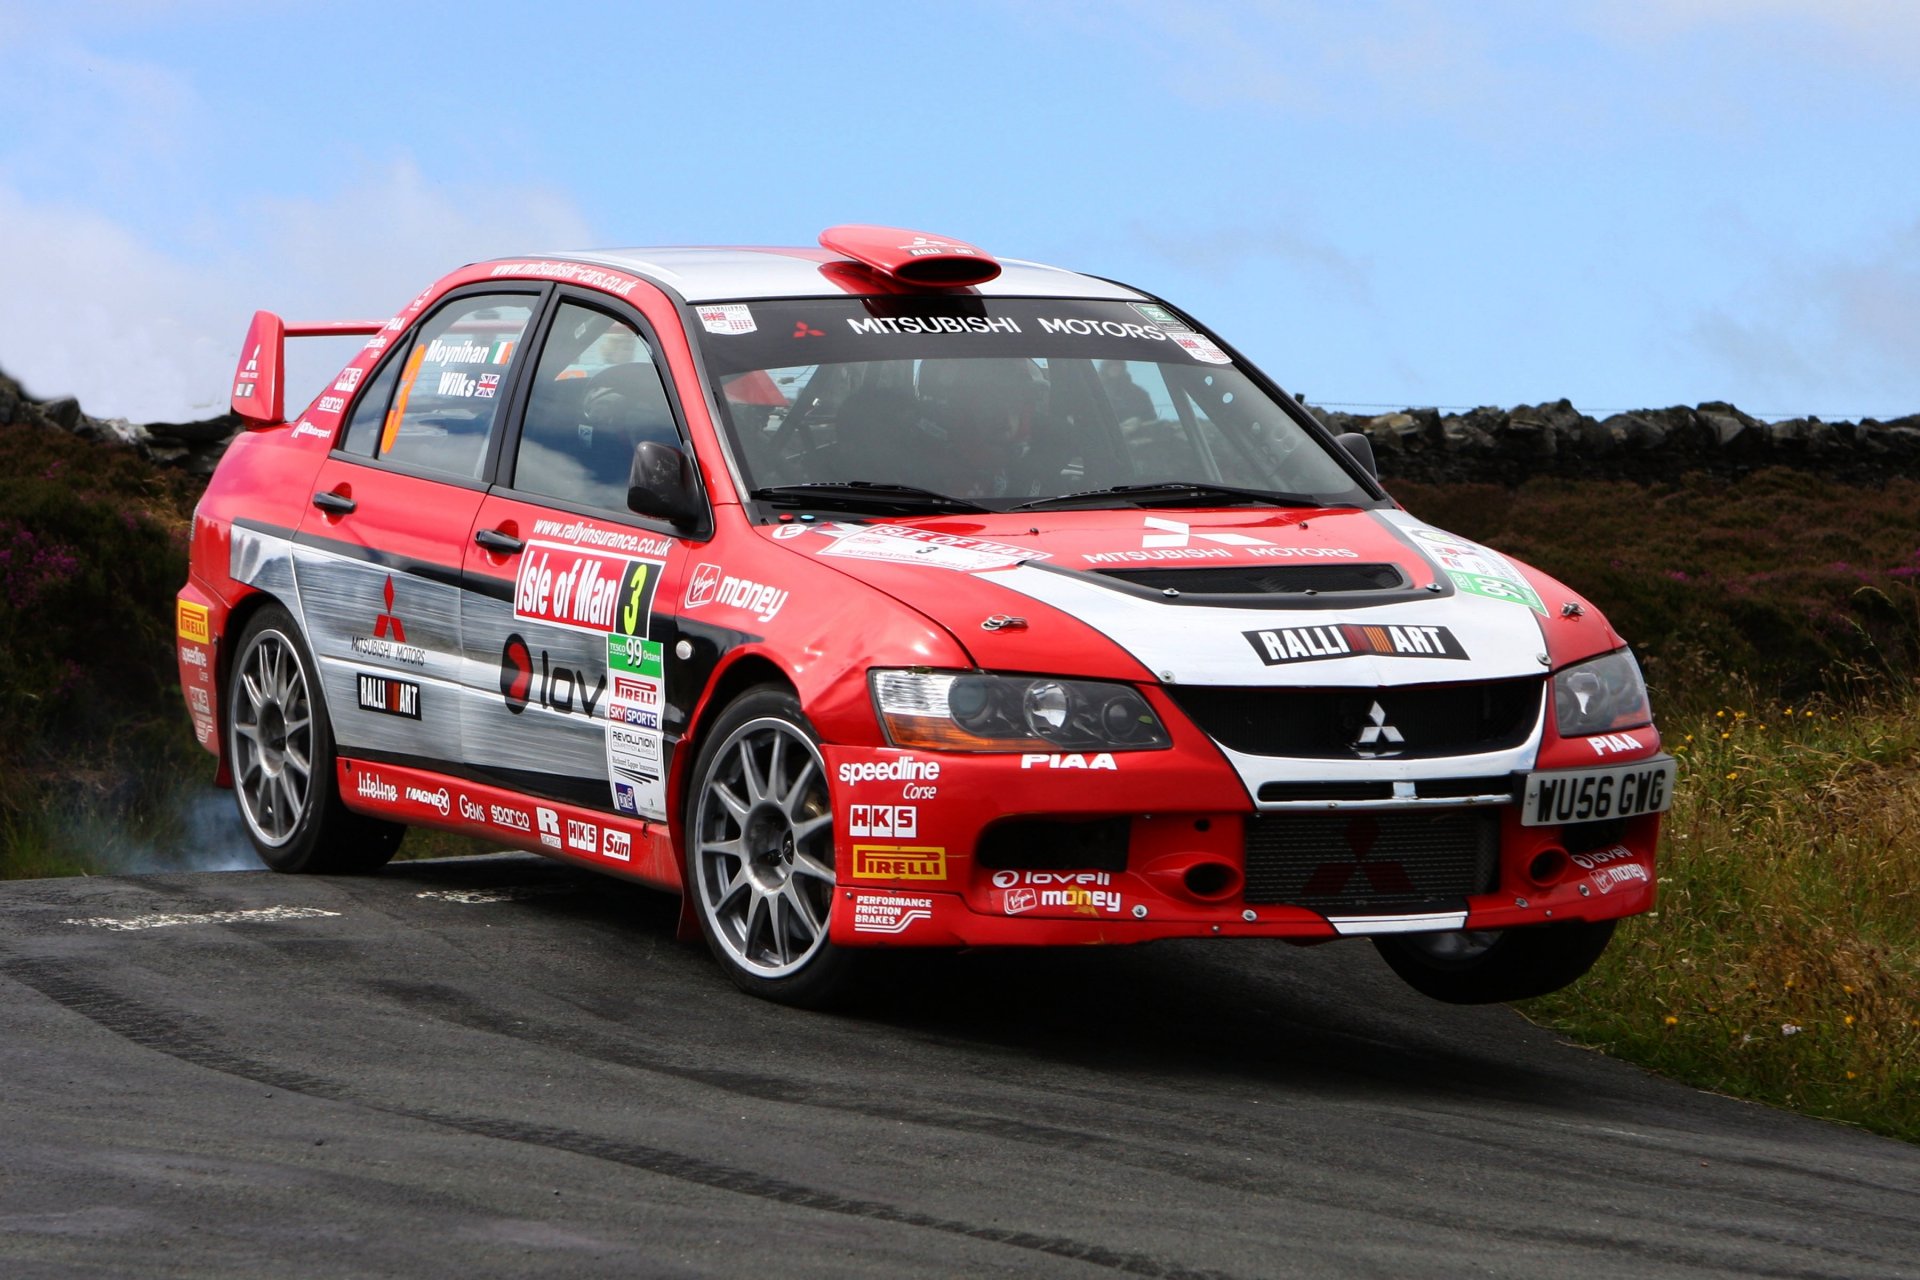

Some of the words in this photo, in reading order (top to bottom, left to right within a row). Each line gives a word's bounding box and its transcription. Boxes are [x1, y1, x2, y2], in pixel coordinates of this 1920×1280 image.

[490, 261, 639, 297] www.mitsubishi-cars.co.uk
[846, 316, 1023, 335] MITSUBISHI
[1037, 316, 1168, 342] MOTORS
[424, 339, 490, 368] Moynihan
[437, 371, 477, 398] Wilks
[533, 519, 673, 557] www.rallyinsurance.co.uk
[915, 546, 939, 555] 3
[928, 534, 977, 549] OF
[1081, 548, 1233, 564] MITSUBISHI
[1245, 547, 1359, 559] MOTORS
[517, 550, 552, 616] Isle
[552, 558, 583, 619] of
[573, 559, 618, 627] Man
[623, 564, 647, 636] 3
[715, 575, 789, 623] money
[351, 635, 393, 659] MITSUBISHI
[395, 644, 426, 667] MOTORS
[609, 642, 626, 653] TESCO
[625, 638, 643, 667] 99
[1257, 625, 1351, 660] RALLI
[1387, 625, 1447, 654] ART
[360, 676, 387, 710] RALLI
[399, 683, 418, 716] ART
[614, 676, 657, 706] PIRELLI
[610, 706, 625, 720] SKY
[626, 708, 657, 727] SPORTS
[612, 730, 656, 749] REVOLUTION
[1586, 733, 1644, 756] PIAA
[838, 756, 940, 786] speedline
[1021, 753, 1118, 770] PIAA
[405, 786, 450, 816] MAGNEX
[902, 782, 938, 800] Corse
[1536, 775, 1615, 823] WU56
[1617, 768, 1667, 815] GWG
[490, 804, 531, 829] sparco
[536, 806, 561, 836] R
[851, 806, 914, 829] HKS
[567, 820, 597, 846] HKS
[604, 833, 630, 858] Sun
[857, 849, 942, 876] PIRELLI
[1586, 845, 1634, 864] lovell
[1024, 871, 1110, 886] lovell
[1607, 863, 1648, 882] money
[855, 905, 901, 916] FRICTION
[857, 896, 932, 908] PERFORMANCE
[1041, 890, 1121, 912] money
[854, 914, 896, 925] BRAKES
